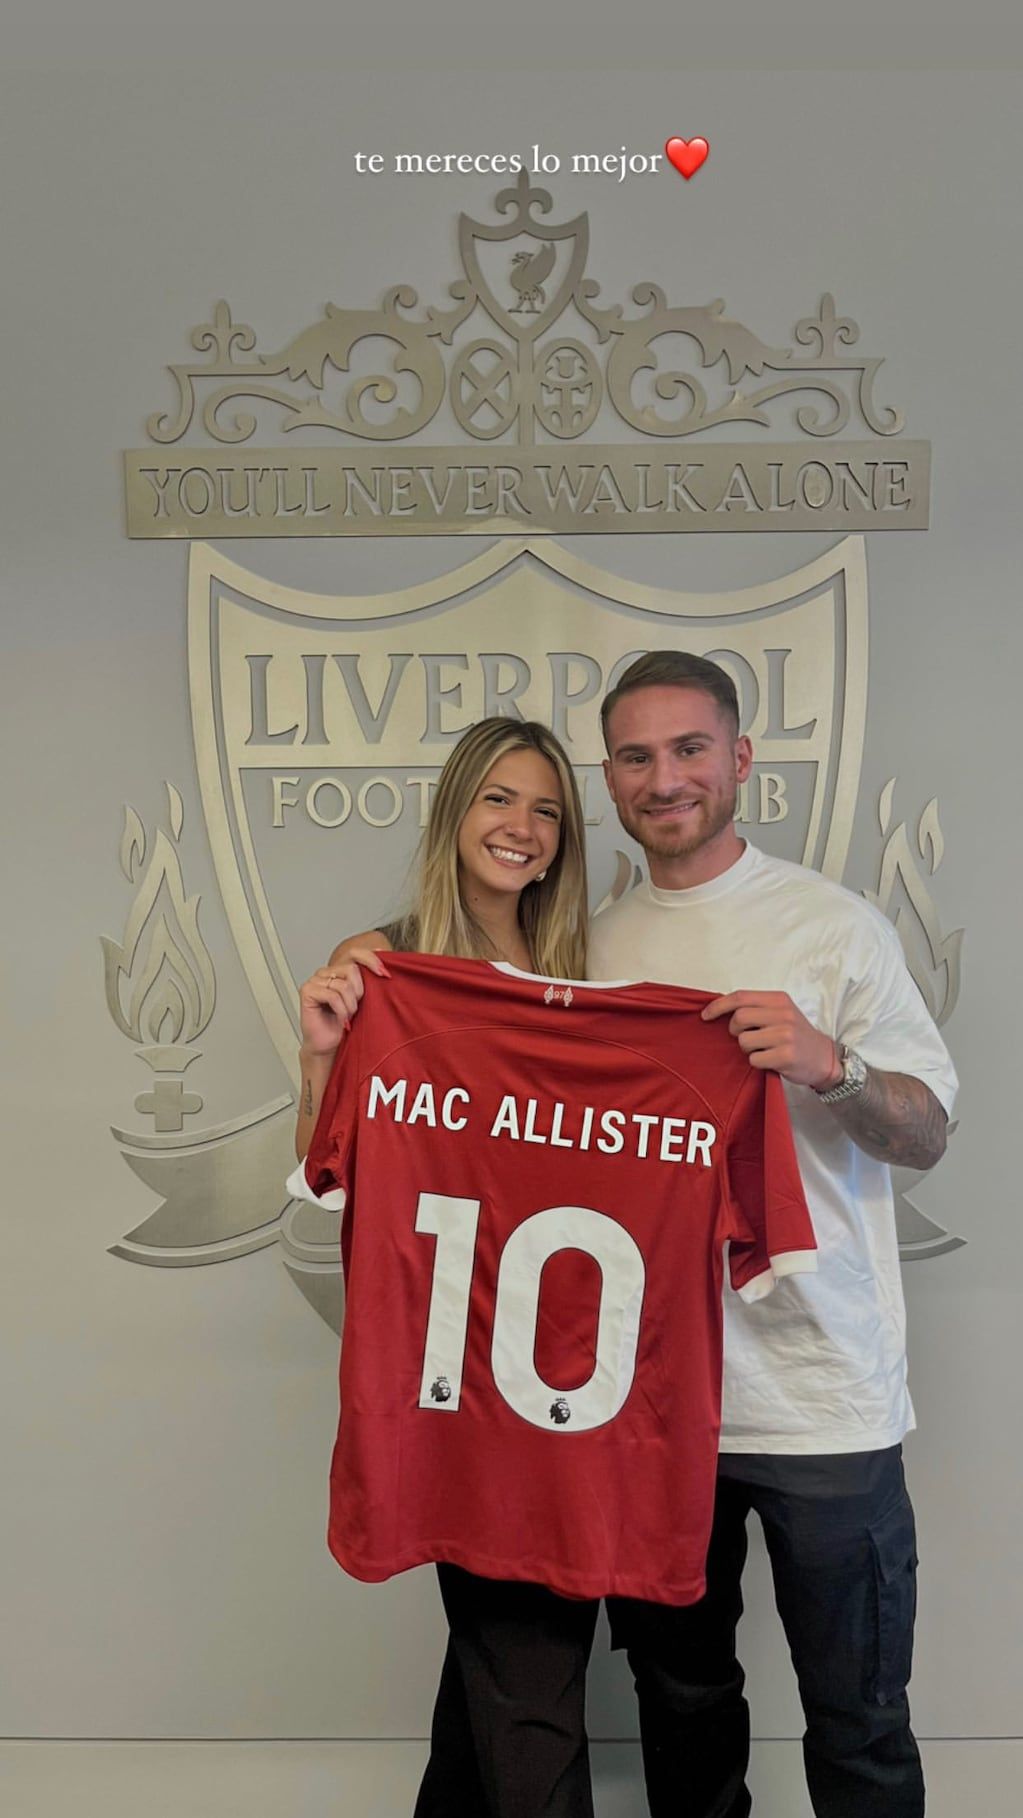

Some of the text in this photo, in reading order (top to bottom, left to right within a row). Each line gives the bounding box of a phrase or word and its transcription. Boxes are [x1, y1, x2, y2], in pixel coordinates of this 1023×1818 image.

[139, 461, 911, 517] YOU'LL NEVER WALK ALONE
[244, 649, 818, 746] LIVERPL
[367, 1075, 470, 1131] MAC
[490, 1095, 717, 1168] ALLISTER
[414, 1192, 646, 1433] 10
